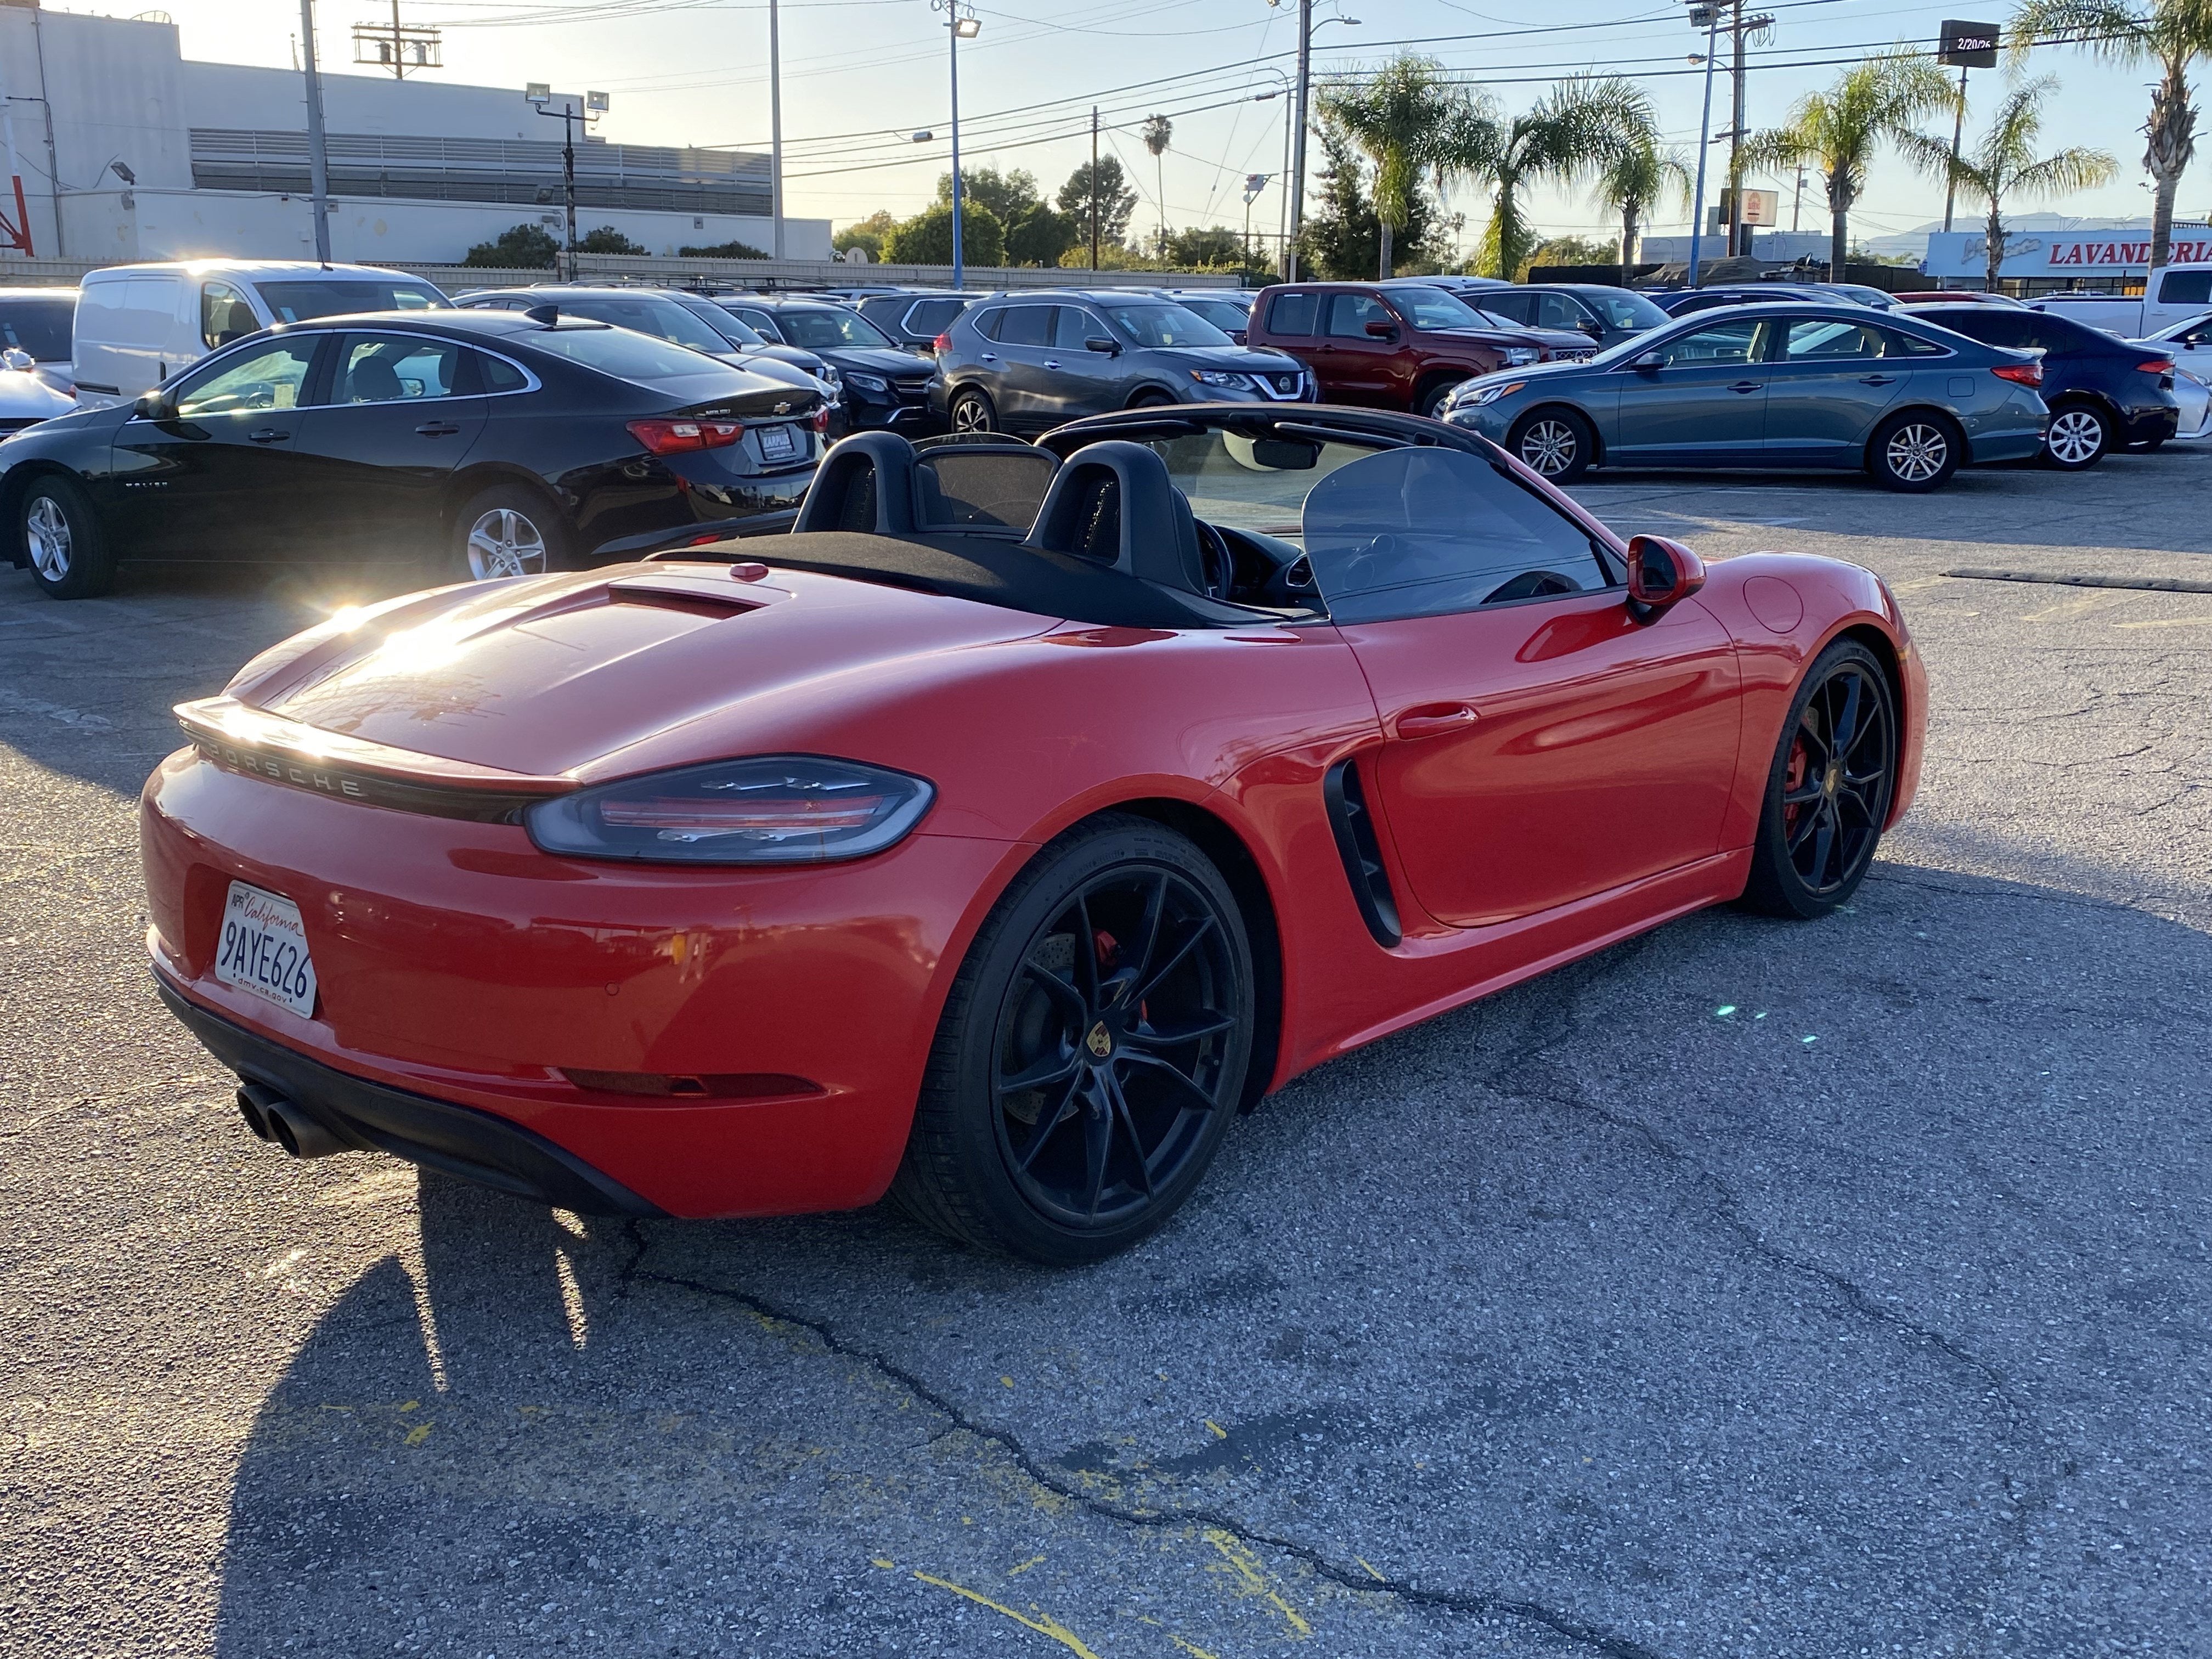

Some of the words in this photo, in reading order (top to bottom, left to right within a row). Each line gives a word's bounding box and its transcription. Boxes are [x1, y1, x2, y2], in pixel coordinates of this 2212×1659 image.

[1957, 38, 1991, 50] 2/20/26
[208, 743, 362, 797] PORSCHE
[231, 893, 245, 909] APR
[245, 896, 304, 937] California
[221, 921, 311, 998] 9AYE626
[238, 978, 287, 1003] dmv.ca.gov
